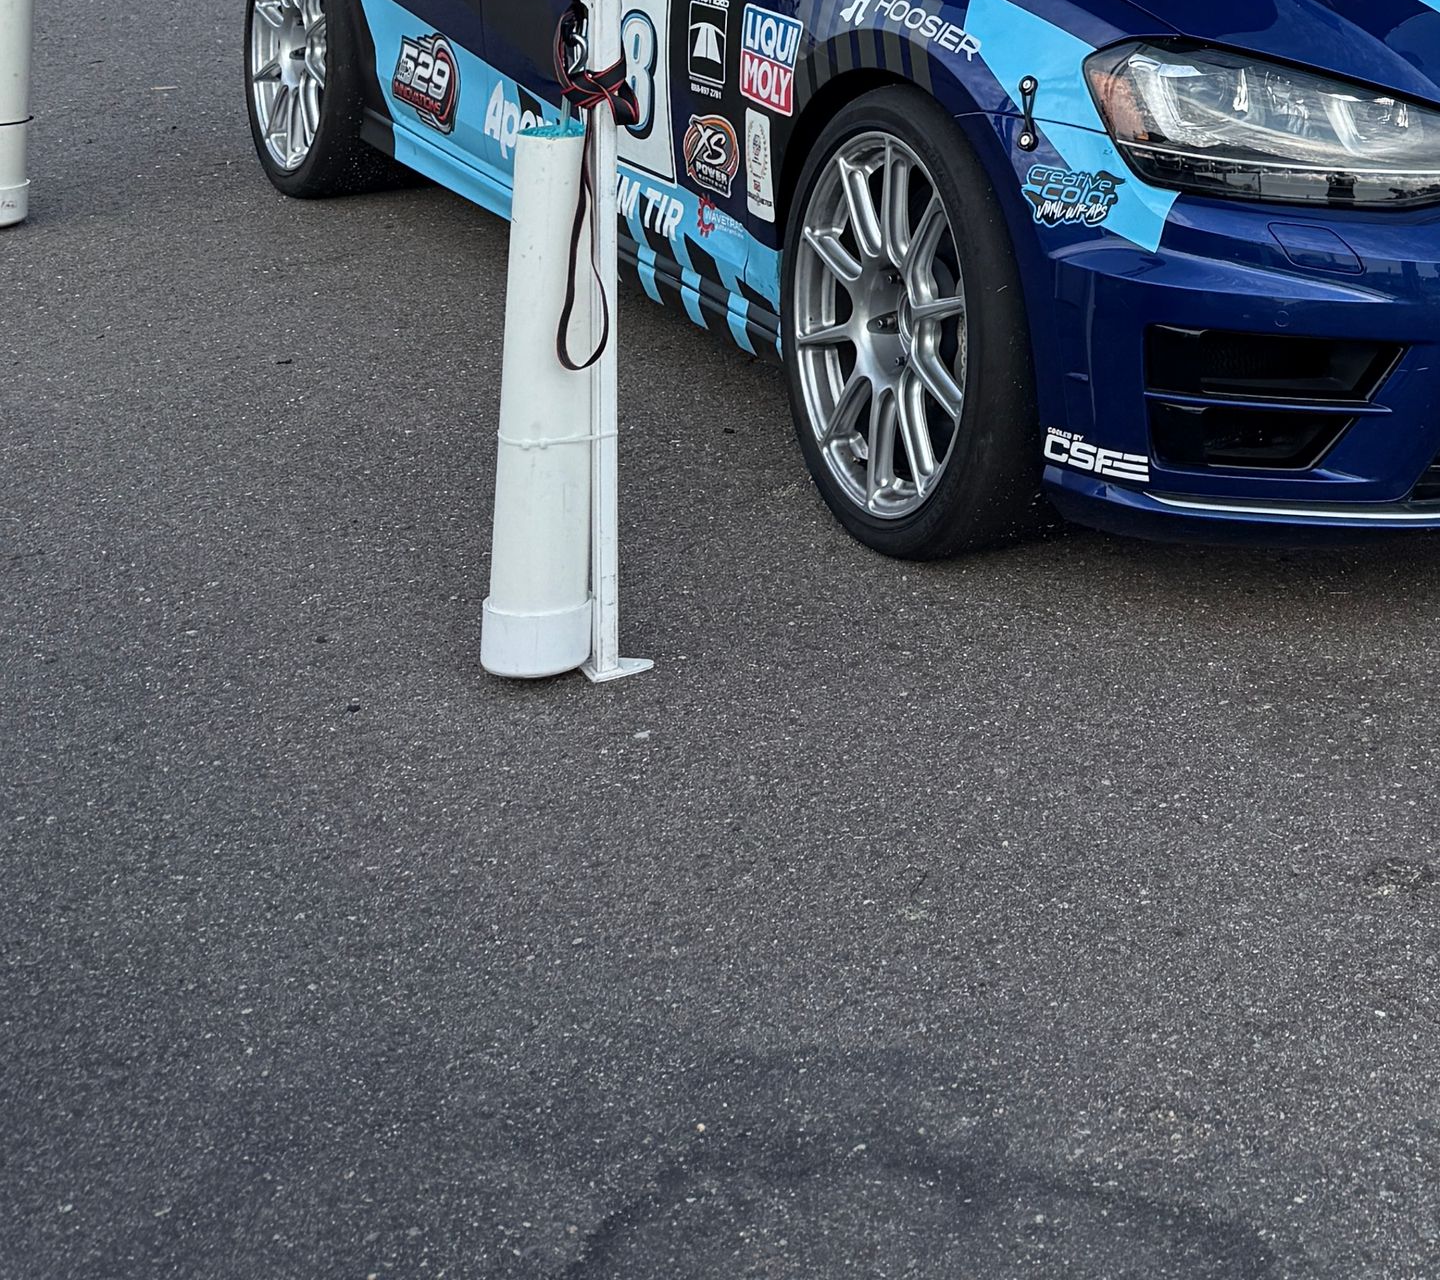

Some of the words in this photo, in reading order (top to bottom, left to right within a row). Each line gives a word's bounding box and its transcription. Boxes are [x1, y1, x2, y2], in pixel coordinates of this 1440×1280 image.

[744, 10, 800, 66] LIQUI
[400, 42, 451, 101] 529
[743, 53, 792, 108] MOLY
[394, 82, 442, 116] INNOVATIONS
[695, 160, 729, 186] POWER
[1030, 168, 1113, 191] creative
[1041, 182, 1115, 207] color
[1072, 433, 1085, 442] BY
